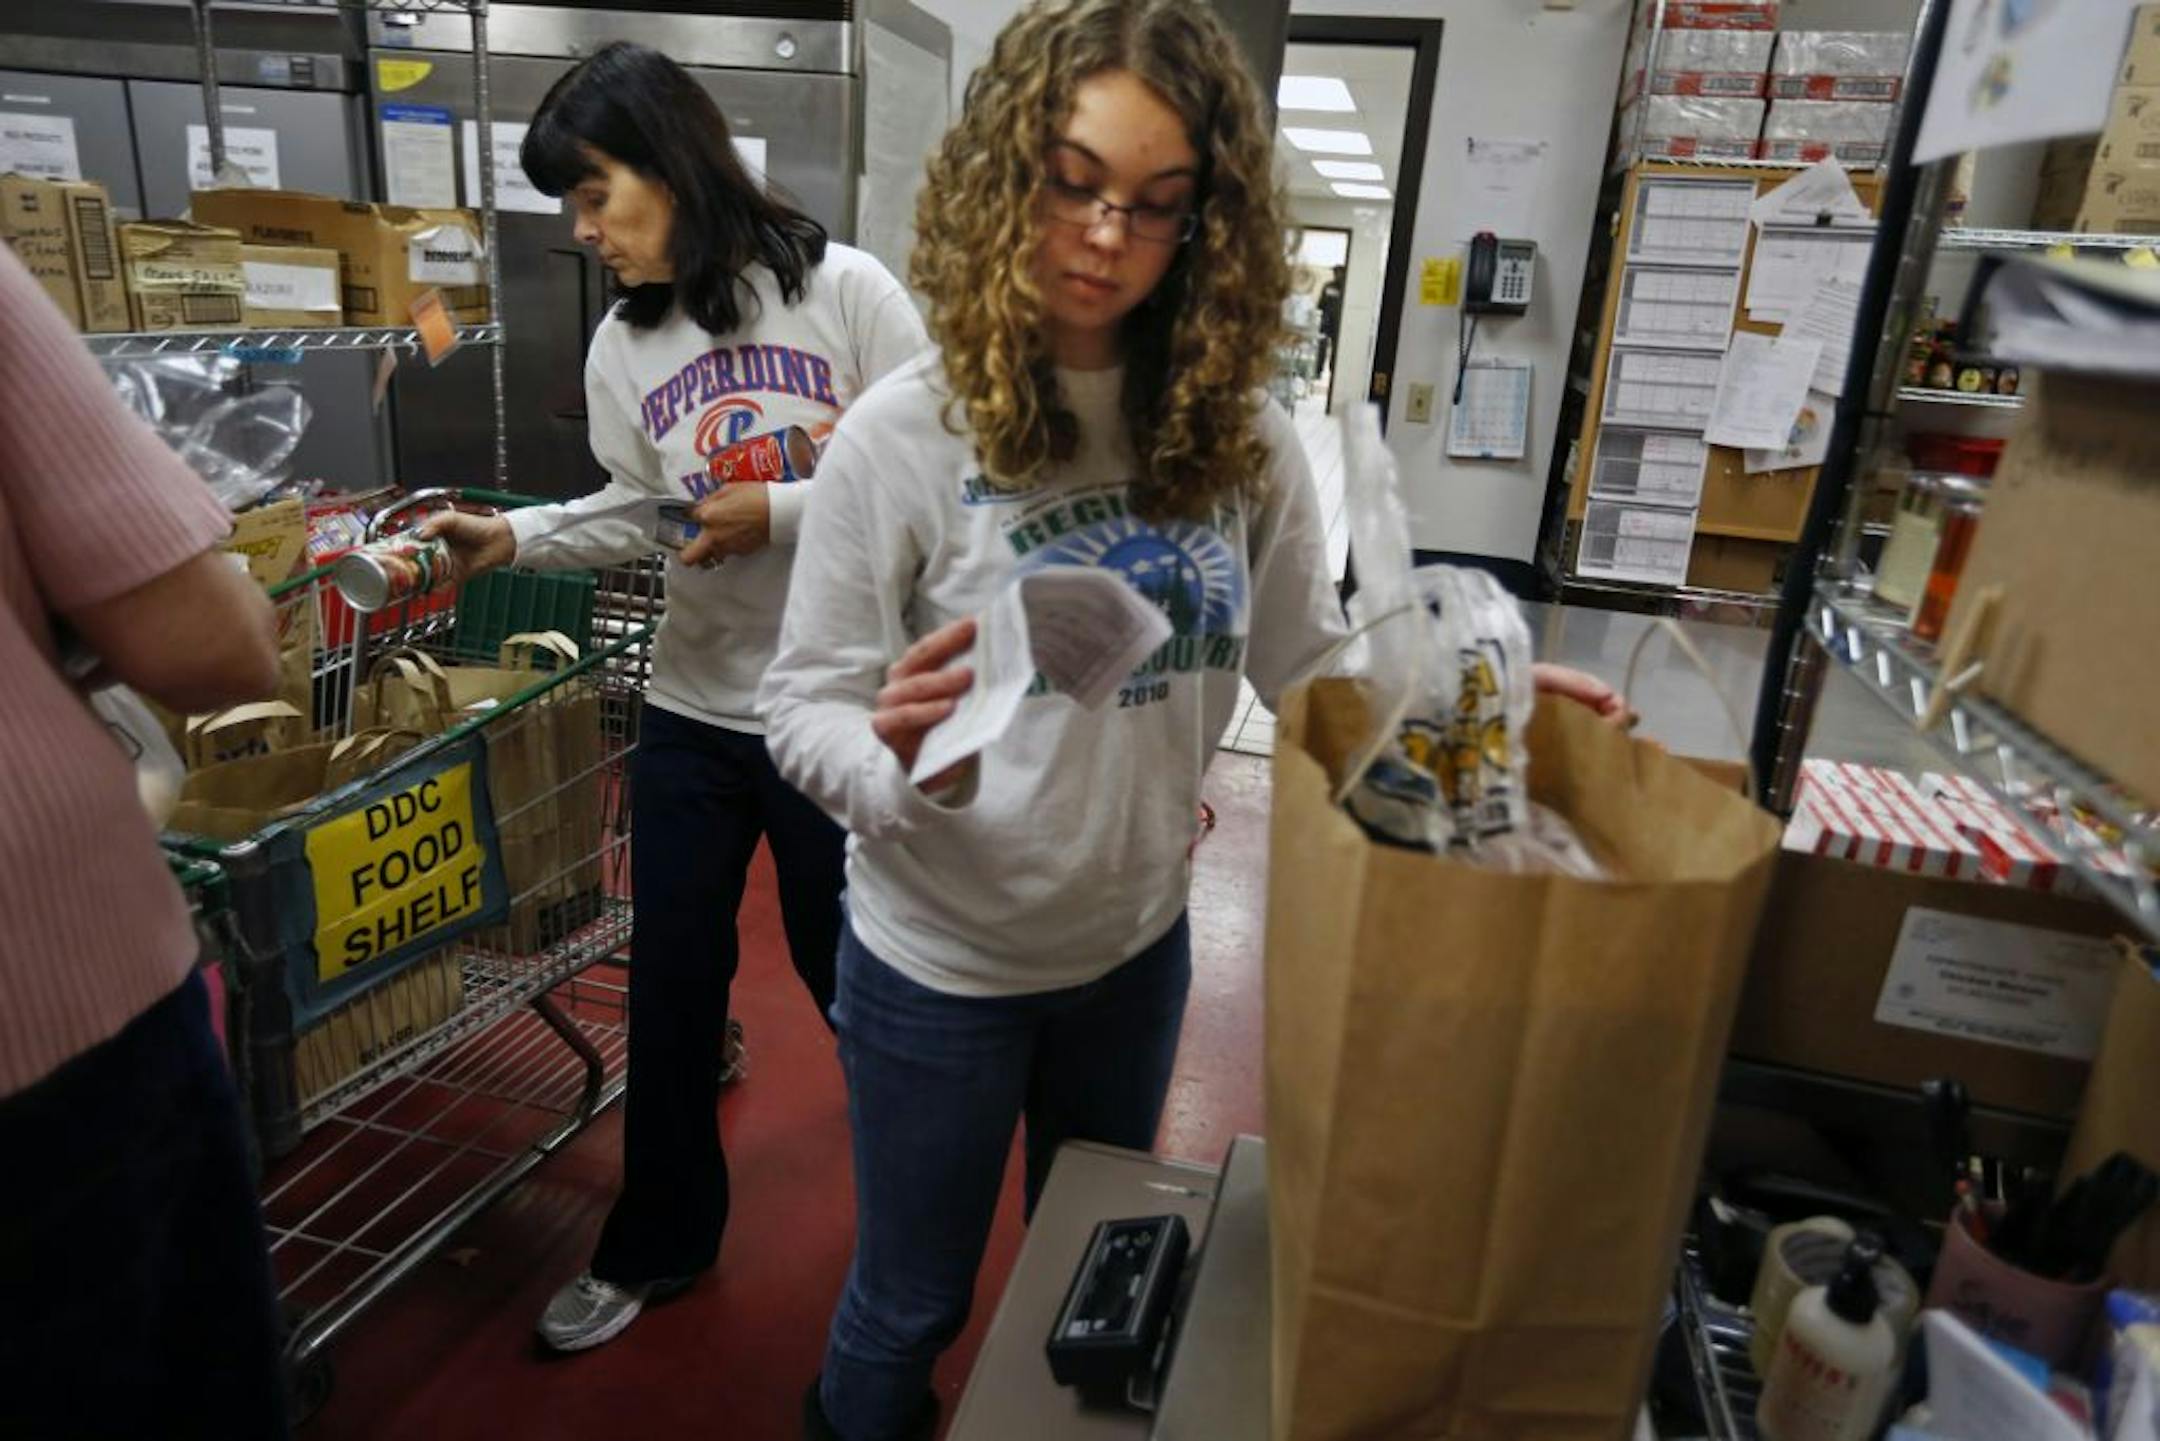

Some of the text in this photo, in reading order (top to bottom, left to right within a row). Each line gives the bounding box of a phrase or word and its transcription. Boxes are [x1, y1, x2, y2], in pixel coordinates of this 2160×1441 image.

[1118, 681, 1169, 708] 2010
[364, 779, 442, 841] DDC
[352, 821, 463, 908] FOOD
[343, 865, 480, 967] SHELF
